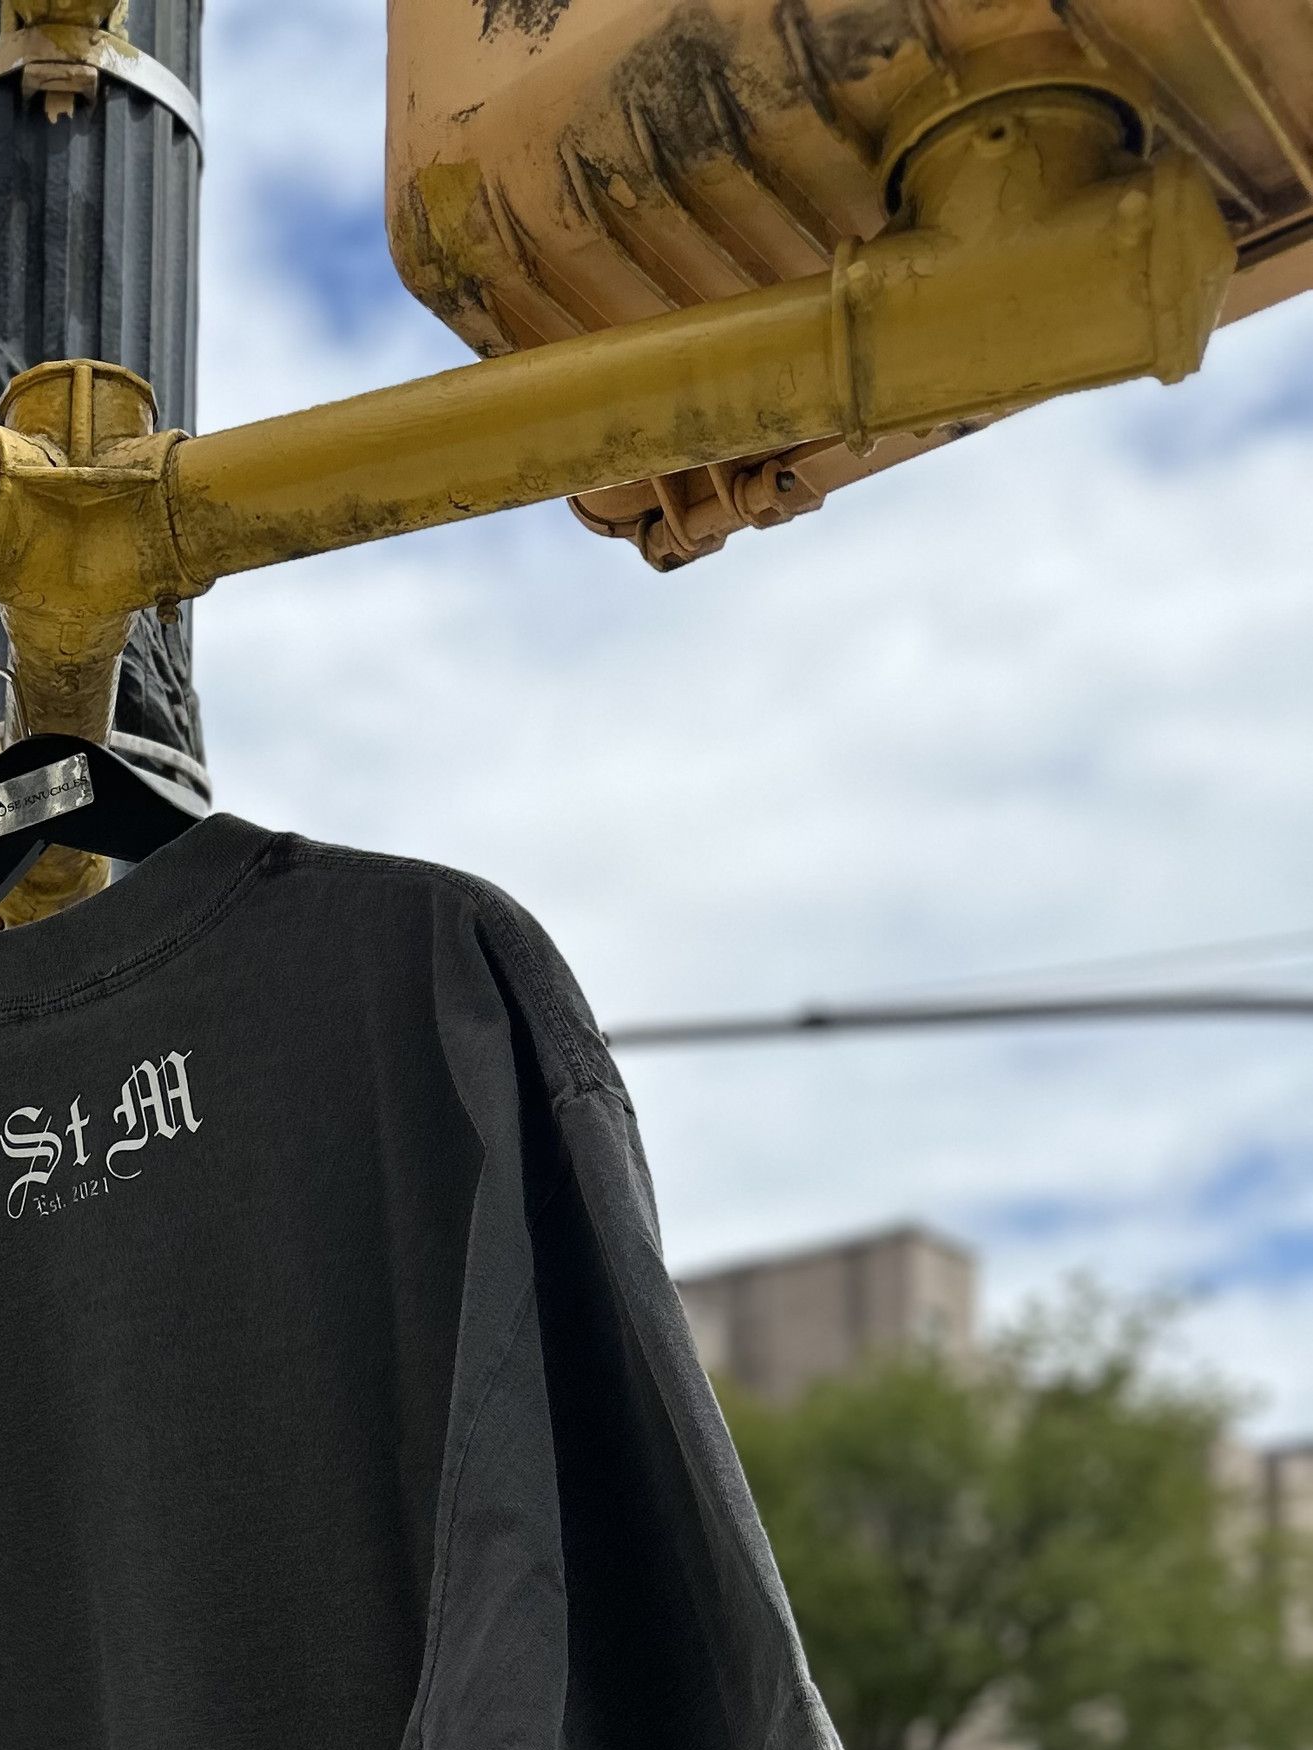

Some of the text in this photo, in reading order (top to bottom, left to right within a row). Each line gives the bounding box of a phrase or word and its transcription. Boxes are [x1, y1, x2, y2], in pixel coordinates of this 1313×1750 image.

[24, 776, 88, 807] KNUCKLES
[0, 1050, 204, 1219] St M
[33, 1177, 109, 1217] Est. 2021
